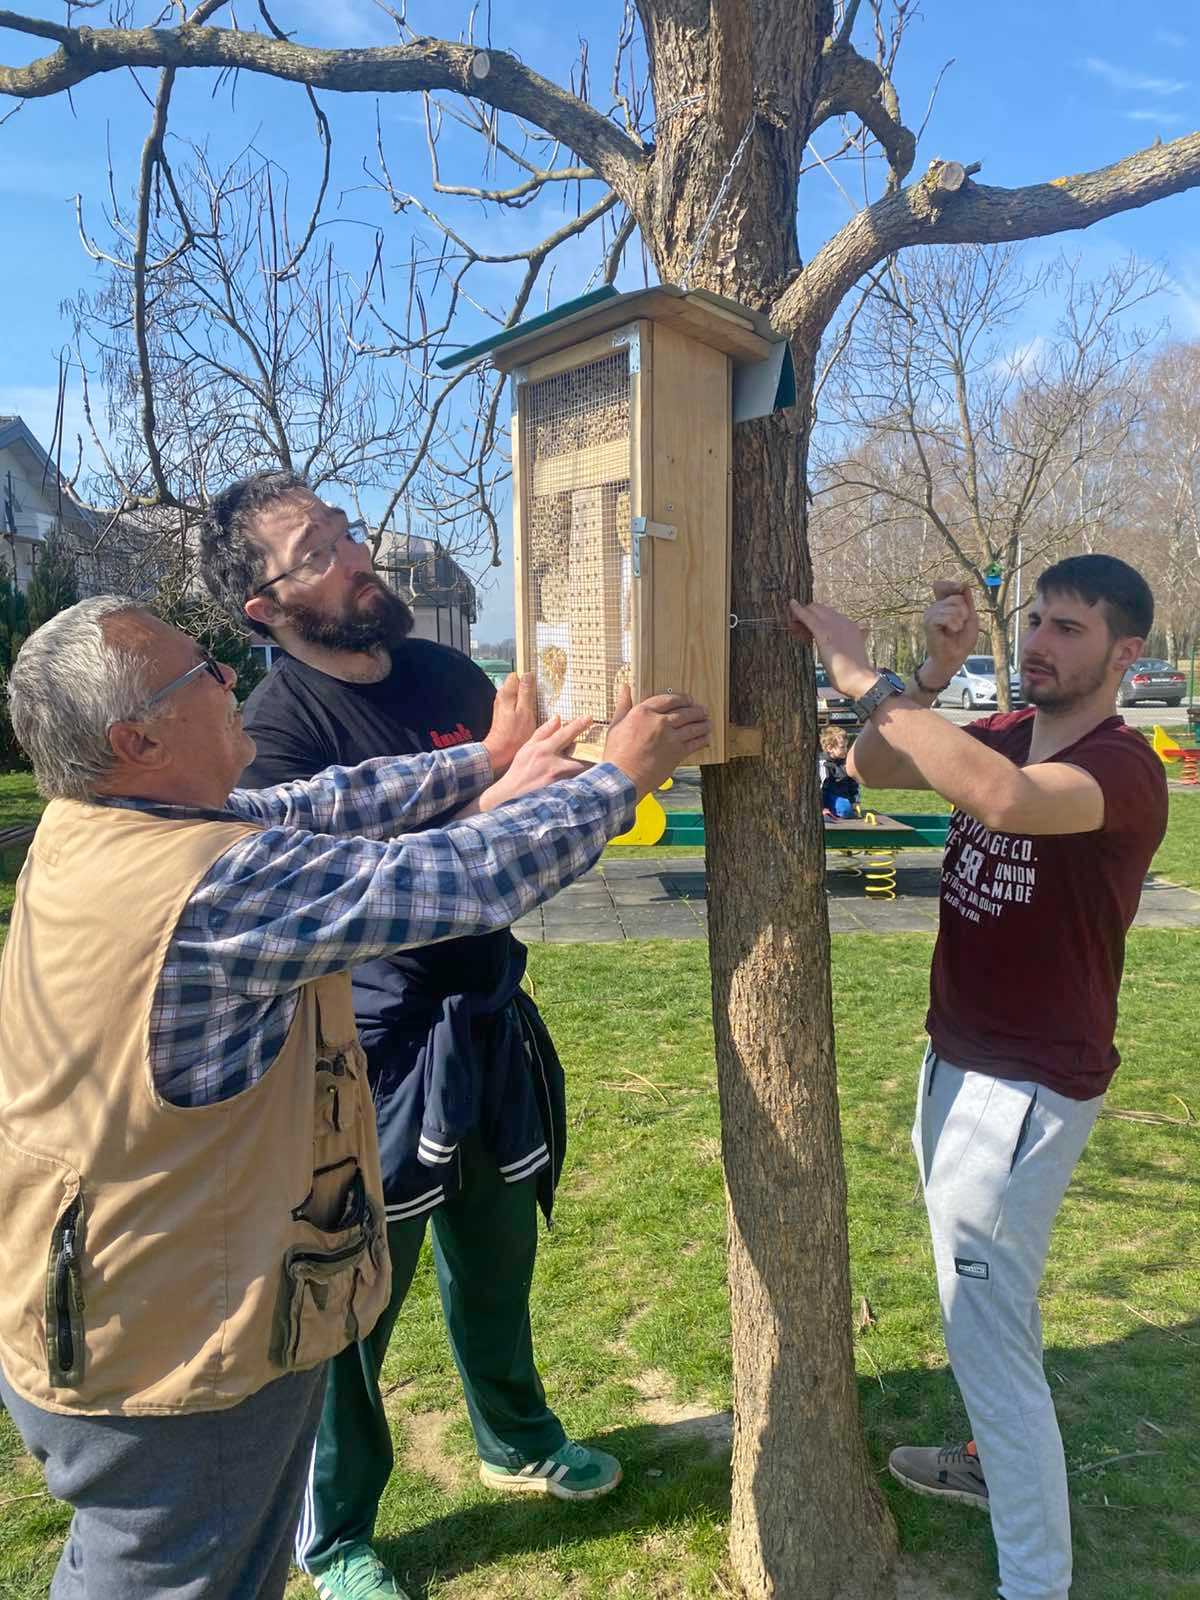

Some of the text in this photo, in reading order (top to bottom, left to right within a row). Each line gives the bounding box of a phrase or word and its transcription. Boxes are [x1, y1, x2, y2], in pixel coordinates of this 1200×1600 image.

[1011, 840, 1038, 861] CO.
[995, 862, 1035, 885] UNION
[992, 881, 1033, 903] MADE
